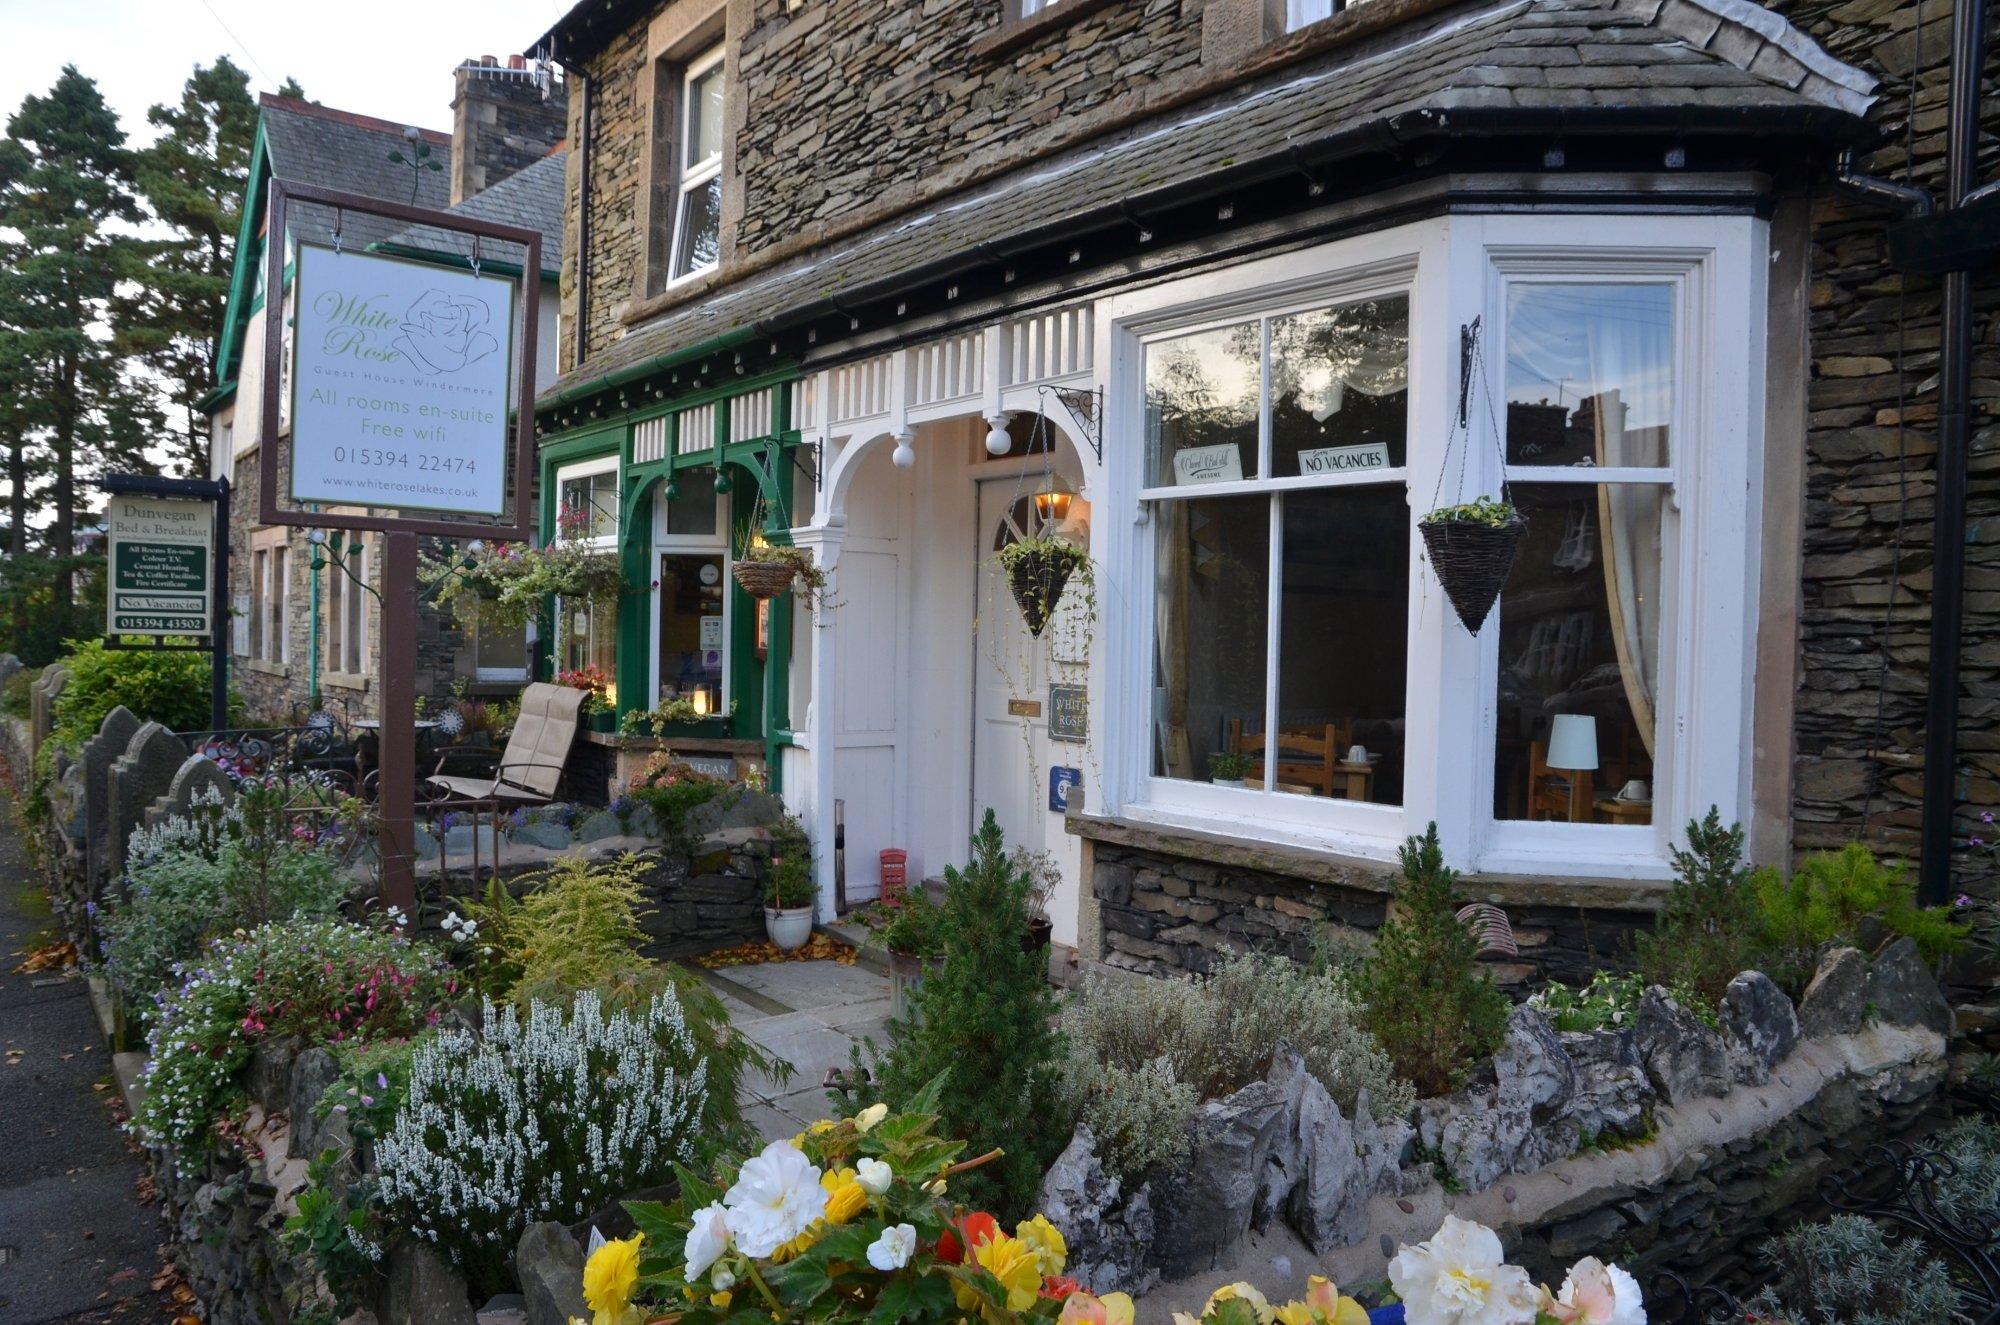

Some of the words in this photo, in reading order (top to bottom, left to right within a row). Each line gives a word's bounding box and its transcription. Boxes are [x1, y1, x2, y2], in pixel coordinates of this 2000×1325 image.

[313, 290, 398, 332] White
[322, 325, 402, 364] Rose
[314, 366, 354, 379] Guest
[364, 372, 406, 385] House
[413, 378, 494, 396] Windermere
[309, 388, 337, 406] All
[347, 394, 409, 415] rooms
[419, 401, 495, 424] en-suite
[361, 417, 404, 439] Free
[413, 422, 446, 442] wifi
[334, 446, 408, 468] 015394
[418, 454, 477, 475] 22474
[1305, 457, 1322, 472] NO
[1325, 452, 1382, 469] VACANCIES
[322, 476, 478, 498] www.whiteroselakes.co.uk
[124, 504, 196, 522] Dunvegan
[115, 521, 138, 533] Bed
[141, 525, 150, 534] &
[155, 524, 208, 537] Breakfast
[141, 546, 165, 554] Rooms
[123, 570, 136, 578] Tea
[146, 571, 169, 579] Coffee
[170, 572, 201, 580] Facilities
[162, 563, 190, 572] Heating
[151, 580, 188, 588] Certificate
[121, 597, 141, 608] No
[146, 598, 201, 610] Vacancies
[121, 618, 163, 628] 015394
[166, 619, 201, 629] 43502
